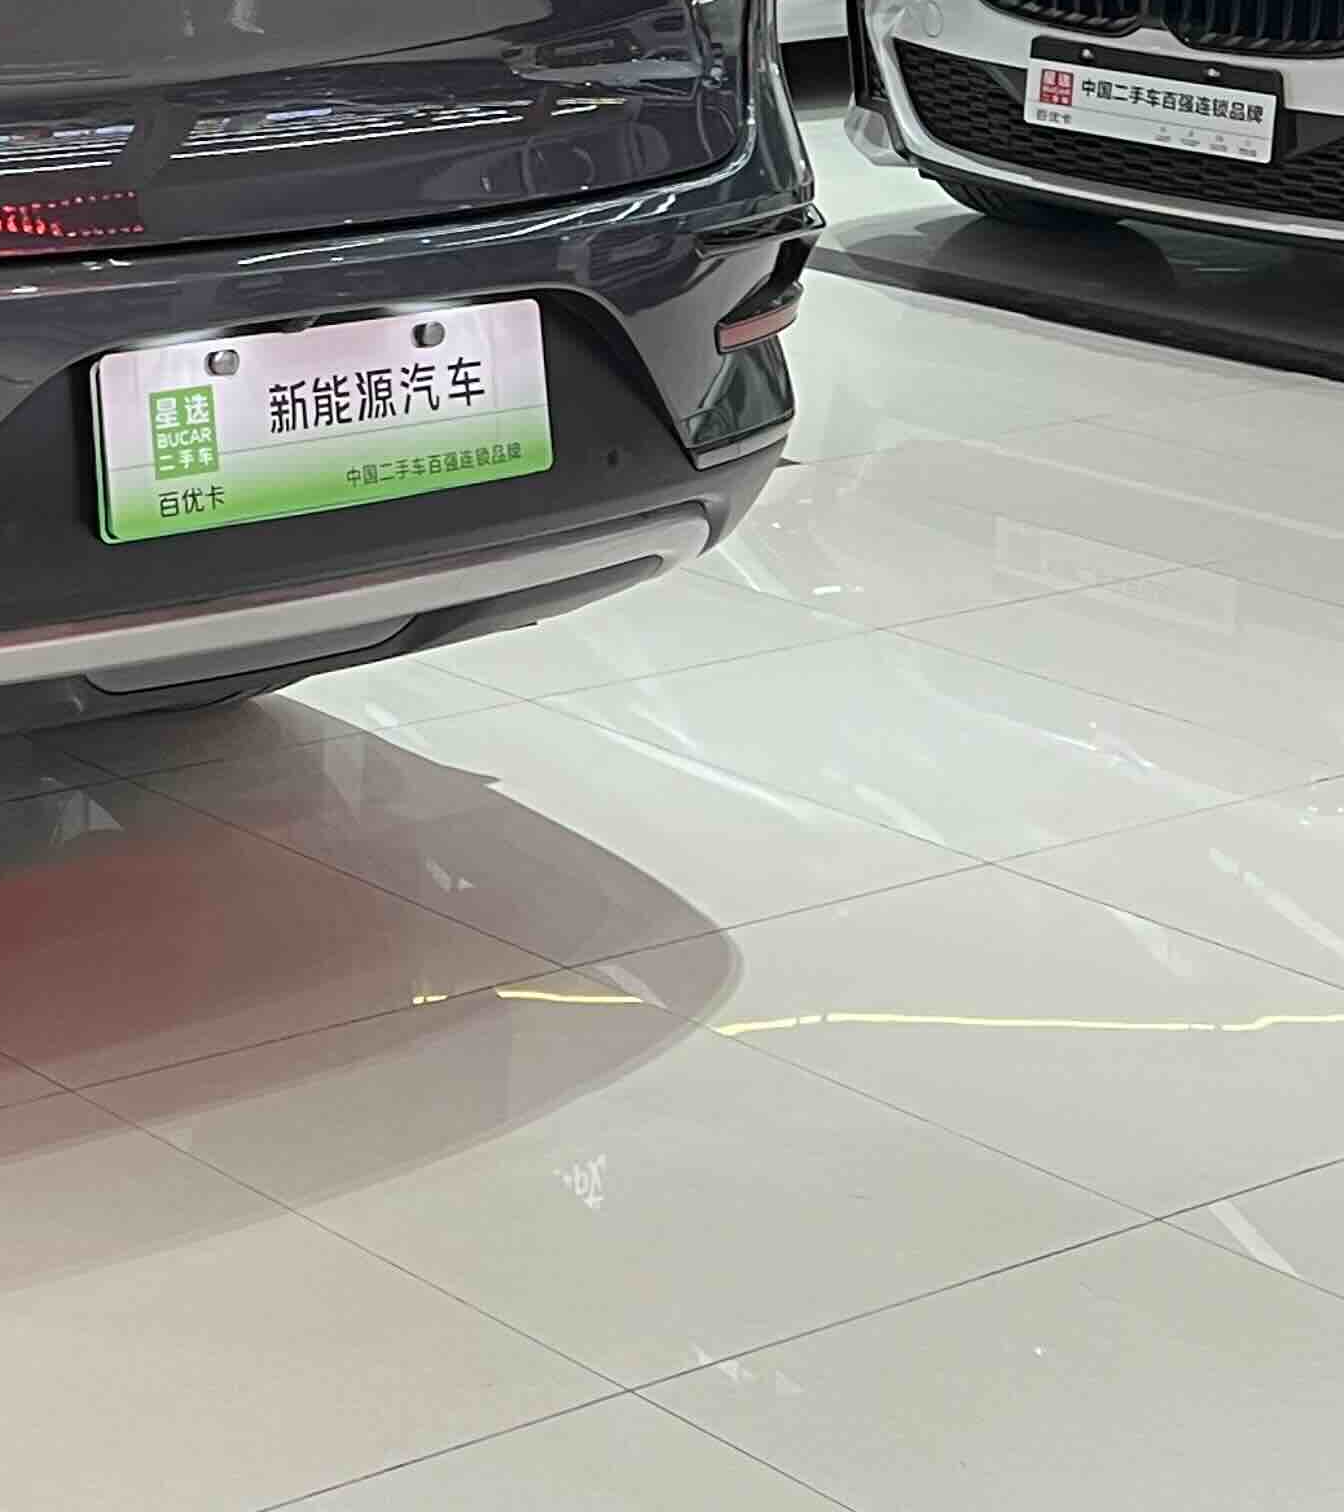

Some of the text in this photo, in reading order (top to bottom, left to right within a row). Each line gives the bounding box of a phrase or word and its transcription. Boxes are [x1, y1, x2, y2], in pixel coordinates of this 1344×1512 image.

[1081, 79, 1264, 124] 中国二手车百强连锁品牌
[155, 393, 210, 430] 星选
[268, 356, 486, 434] 新能源汽车
[157, 427, 212, 449] BUCAR
[159, 447, 213, 472] 二手车
[346, 442, 521, 487] 中国二手车百强连锁品牌
[158, 485, 225, 518] 百优卡
